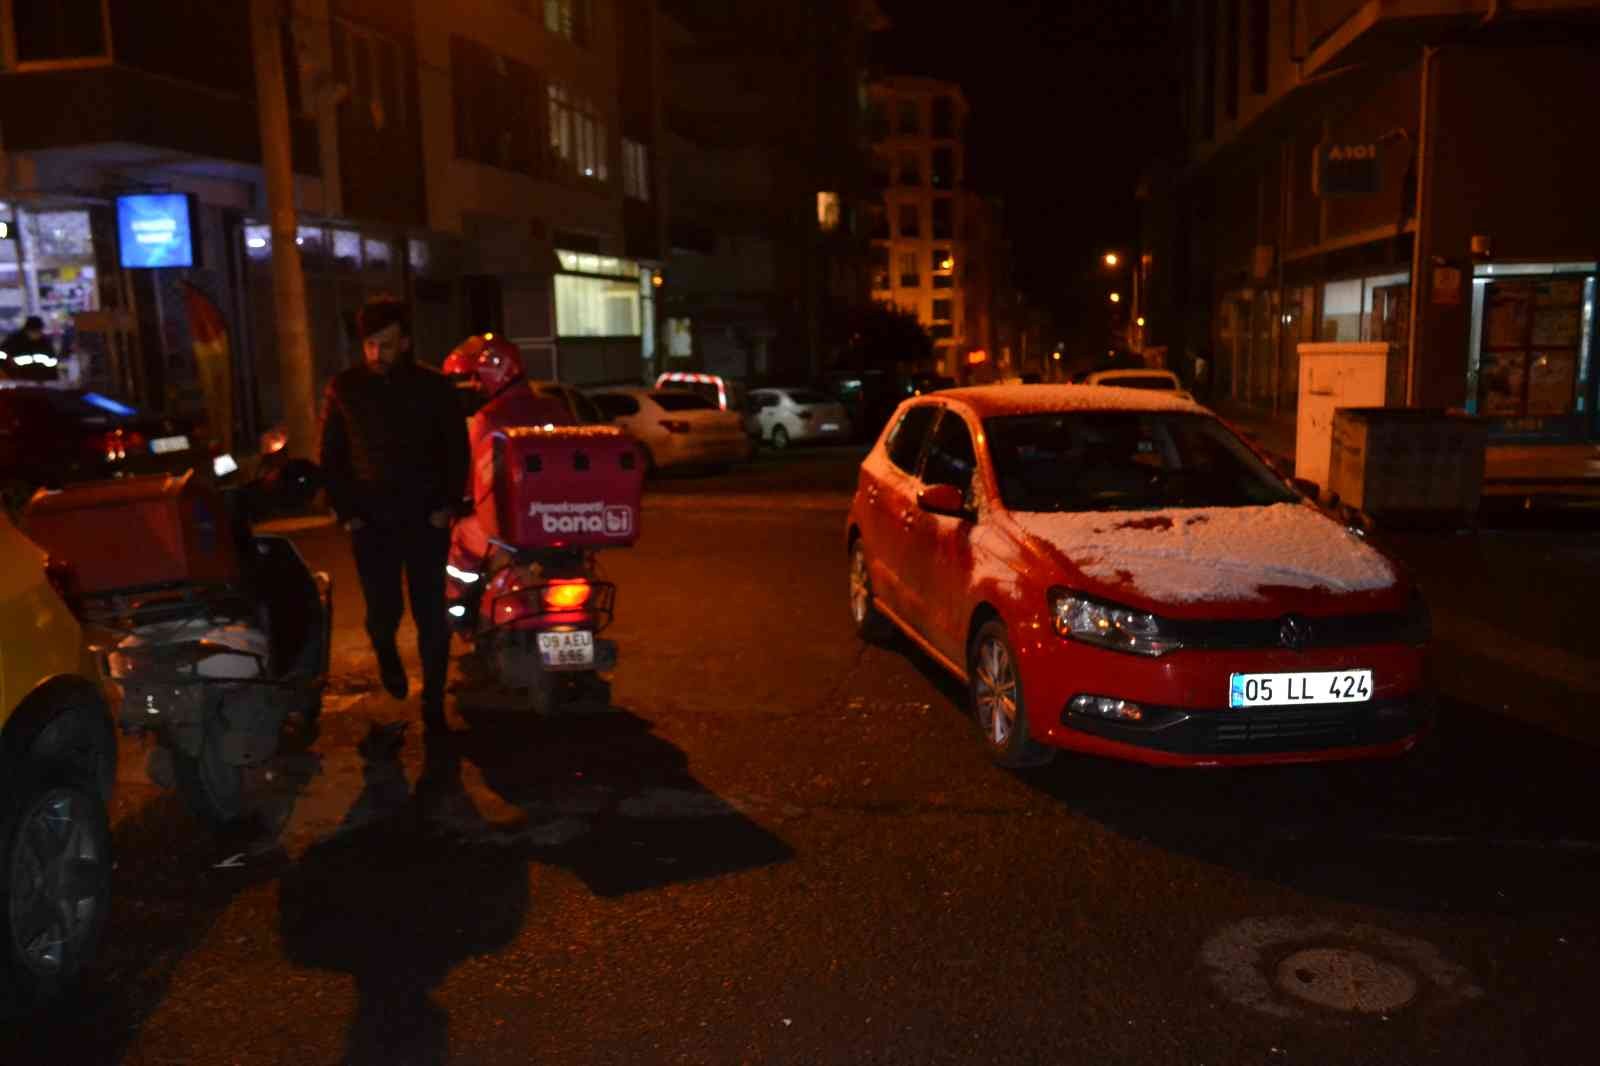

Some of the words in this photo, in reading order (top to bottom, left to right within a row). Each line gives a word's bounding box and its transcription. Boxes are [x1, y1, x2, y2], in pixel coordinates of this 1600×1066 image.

[1245, 678, 1273, 701] 05
[1287, 677, 1314, 700] LL
[1329, 675, 1369, 699] 424
